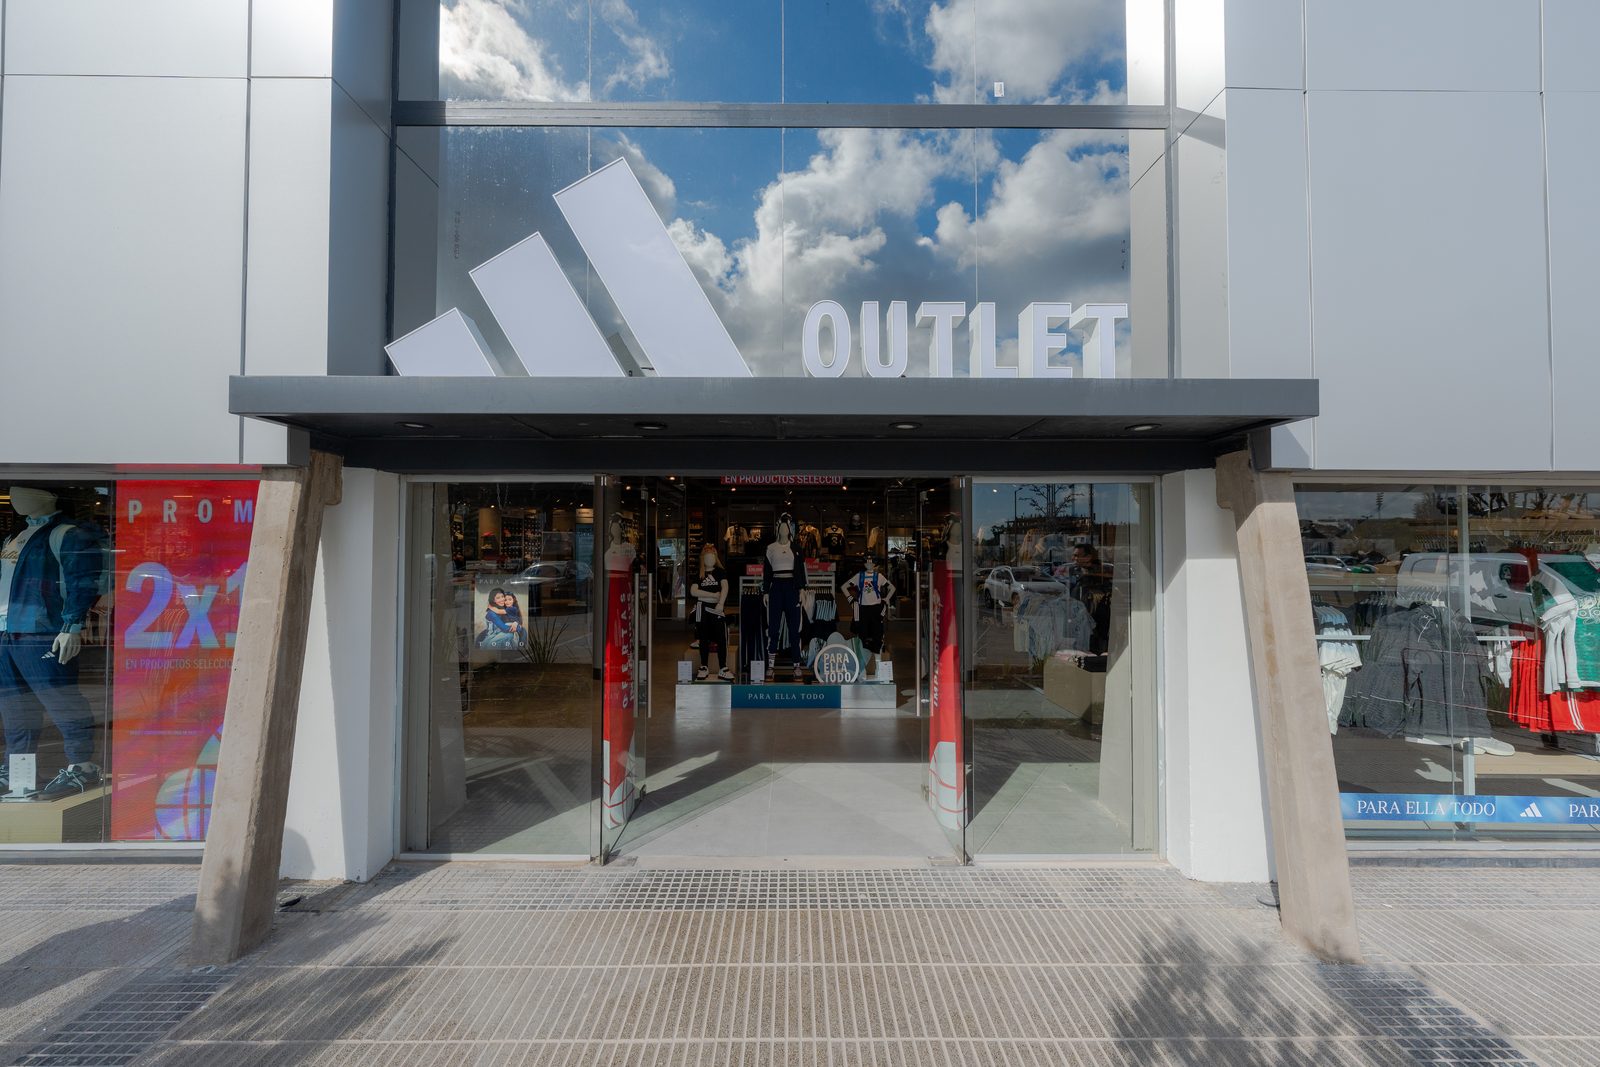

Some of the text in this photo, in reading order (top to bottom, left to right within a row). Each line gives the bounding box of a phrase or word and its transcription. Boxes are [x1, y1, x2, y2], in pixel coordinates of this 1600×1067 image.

[802, 299, 1128, 378] OUTLET
[725, 474, 737, 484] EN
[740, 474, 795, 484] PRODUCTOS
[128, 499, 253, 524] PROM
[620, 593, 629, 708] OFERTAS
[125, 658, 137, 670] EN
[140, 658, 191, 670] PRODUCTOS
[823, 653, 849, 663] PARA
[824, 663, 847, 673] ELLA
[824, 672, 850, 682] TODO
[1357, 800, 1495, 816] PARA ELLA TODO
[1569, 804, 1600, 818] PAR
